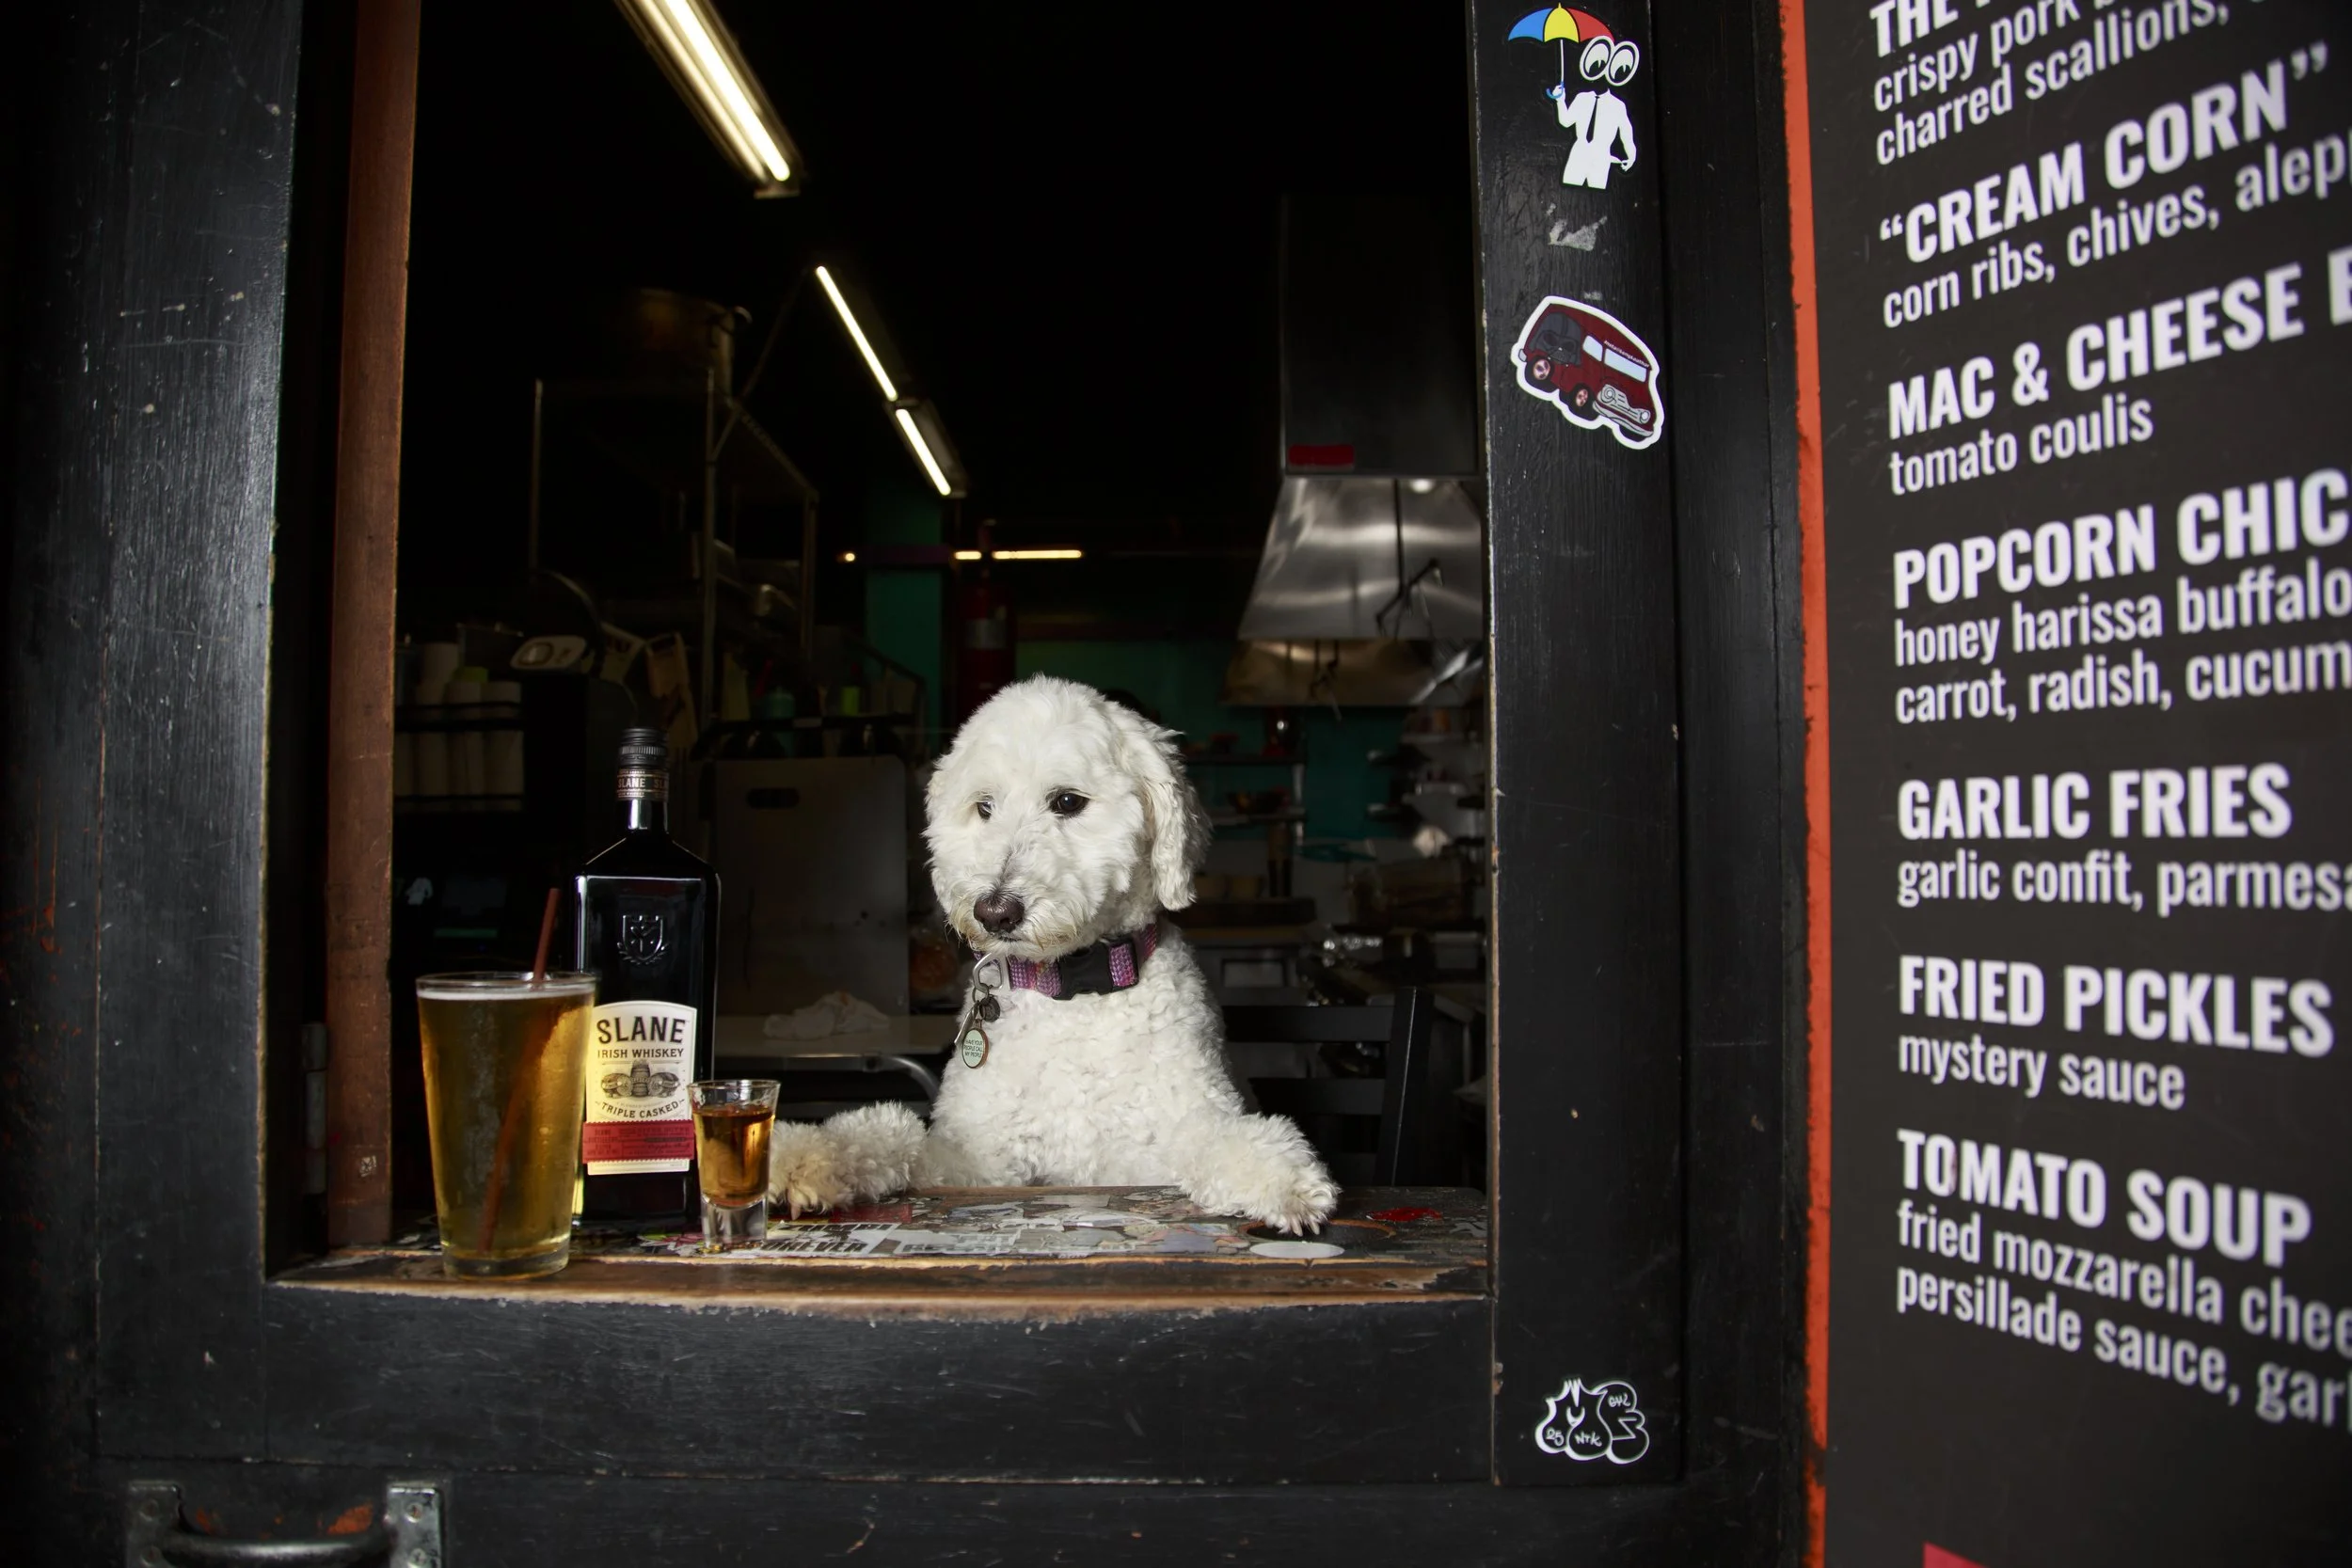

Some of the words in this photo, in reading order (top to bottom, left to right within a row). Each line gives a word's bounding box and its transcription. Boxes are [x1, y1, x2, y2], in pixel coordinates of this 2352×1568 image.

[1874, 32, 1979, 112] crispy
[1876, 62, 2012, 166] charred
[2025, 0, 2230, 100] scallions,
[1880, 142, 2086, 263] “CREAM
[2105, 41, 2328, 190] CORN”
[1883, 271, 1961, 328] corn
[1972, 239, 2056, 300] ribs,
[2067, 185, 2220, 267] chives,
[2235, 130, 2352, 212] alep
[1888, 356, 1995, 440] MAC
[2011, 341, 2049, 406] &
[2066, 263, 2305, 391] CHEESE
[1888, 429, 2018, 496] tomato
[2029, 392, 2154, 464] coulis
[1893, 504, 2155, 610] POPCORN
[2177, 468, 2350, 565] CHIC
[1894, 617, 2001, 667] honey
[2011, 593, 2164, 654] harissa
[2177, 556, 2352, 635] buffalo
[1896, 668, 2017, 724] carrot,
[2028, 648, 2173, 714] radish,
[2185, 641, 2352, 702] cucum
[1898, 771, 2090, 840] GARLIC
[2109, 763, 2293, 839] FRIES
[1897, 847, 2000, 908] garlic
[2011, 848, 2143, 912] confit,
[596, 1016, 687, 1044] SLANE
[597, 1049, 628, 1058] IRISH
[631, 1048, 685, 1058] WHISKEY
[1899, 955, 2045, 1027] FRIED
[2064, 965, 2334, 1057] PICKLES
[602, 1101, 636, 1118] TRIPLE
[639, 1101, 679, 1118] CASKED
[1899, 1034, 2047, 1099] mystery
[2059, 1053, 2185, 1110] sauce
[1897, 1128, 2107, 1228] TOMATO
[2127, 1169, 2312, 1268] SOUP
[1897, 1198, 1981, 1263] fried
[1994, 1230, 2223, 1323] mozzarella
[2240, 1277, 2352, 1360] chee
[1897, 1267, 2081, 1352] persillade
[2095, 1320, 2240, 1406] sauce,
[2255, 1361, 2352, 1435] gar
